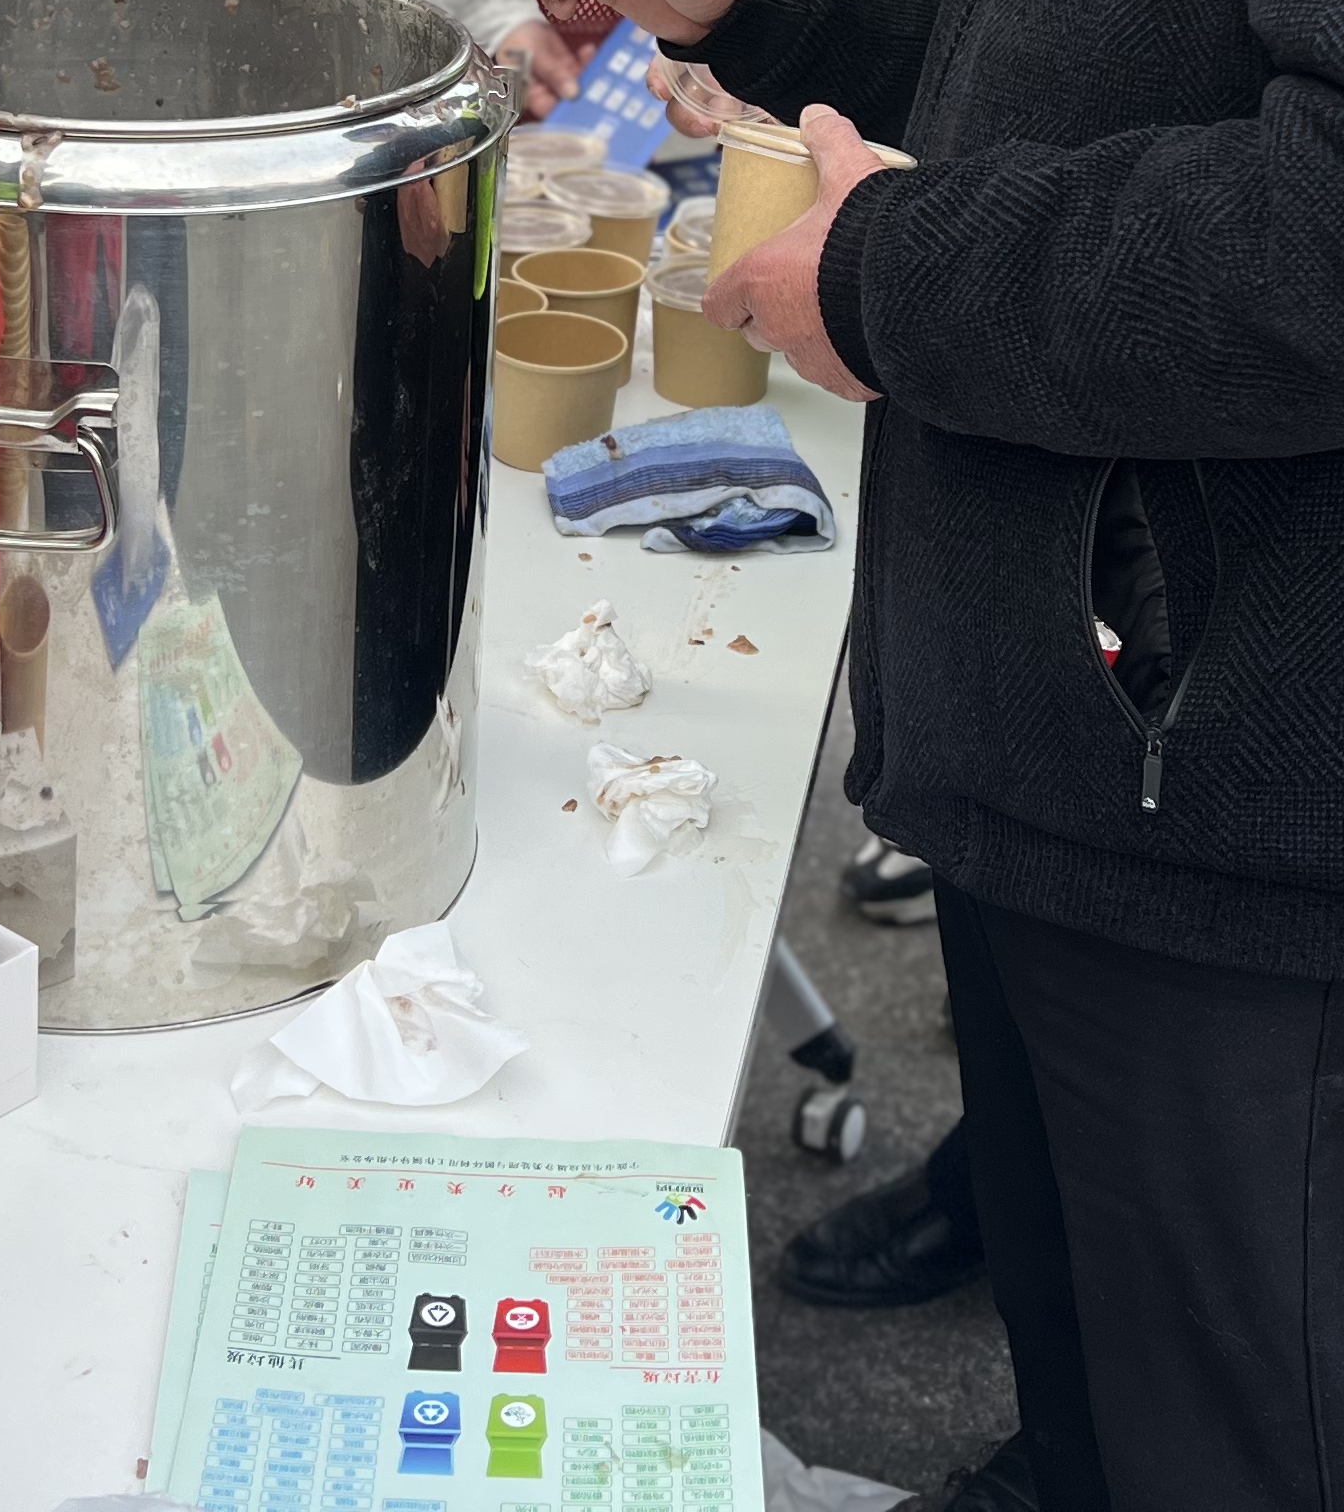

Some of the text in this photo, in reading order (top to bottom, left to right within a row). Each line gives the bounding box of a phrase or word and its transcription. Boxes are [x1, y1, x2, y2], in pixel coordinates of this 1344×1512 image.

[227, 1349, 304, 1371] 其他垃圾
[641, 1370, 722, 1384] 有害垃圾
